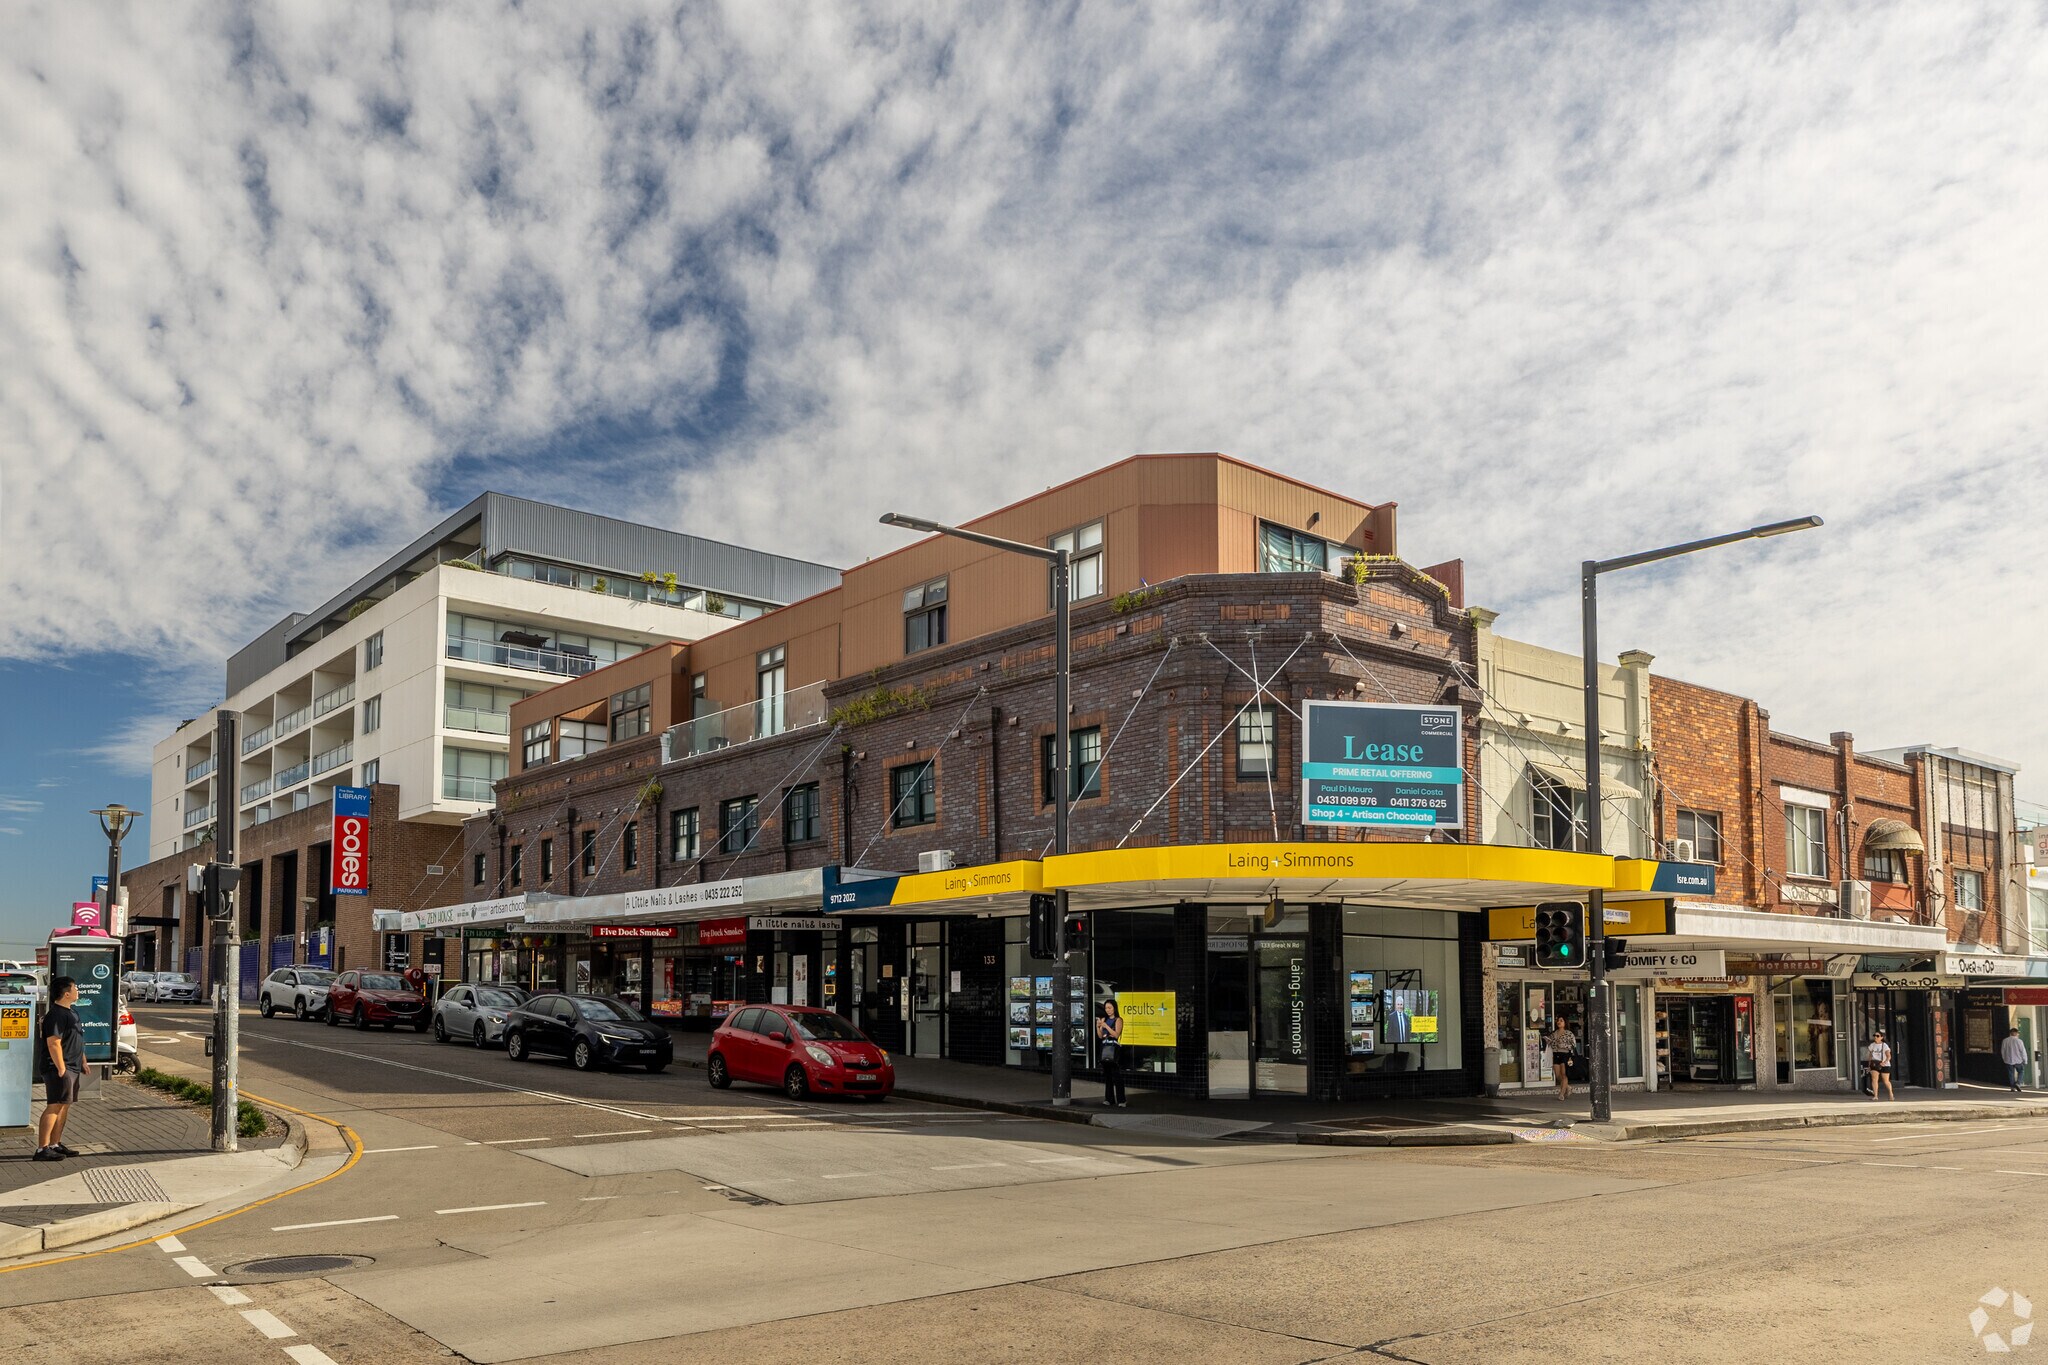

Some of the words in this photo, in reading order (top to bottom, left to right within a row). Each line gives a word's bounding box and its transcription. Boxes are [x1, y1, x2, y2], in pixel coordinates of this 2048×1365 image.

[1344, 735, 1424, 762] Lease
[1332, 767, 1359, 776] PRIME
[1360, 768, 1388, 778] RETAIL
[1390, 769, 1432, 779] OFFERING
[338, 793, 367, 801] LIBRARY
[1396, 787, 1420, 795] Daniel
[1421, 788, 1444, 796] Costa
[1317, 795, 1339, 804] 0431
[1340, 796, 1360, 805] 099
[1361, 797, 1377, 806] 976
[1390, 798, 1409, 807] 0411
[1411, 799, 1428, 808] 376
[1429, 799, 1447, 808] 625
[1312, 809, 1336, 819] Shop
[1337, 810, 1343, 818] 4
[1352, 810, 1384, 819] Artisan
[1386, 811, 1432, 822] Chocolate
[341, 818, 362, 886] coles
[1283, 852, 1354, 867] Simmons
[974, 873, 1011, 887] Simmons
[1676, 874, 1707, 885] lsre.com.au
[626, 897, 630, 908] A
[631, 896, 649, 908] Little
[650, 894, 666, 907] Nails
[668, 894, 673, 905] &
[675, 892, 698, 905] Lashes
[704, 888, 719, 900] 0435
[719, 887, 730, 899] 222
[731, 886, 742, 898] 252
[830, 893, 842, 904] 9712
[843, 893, 855, 902] 2022
[490, 904, 508, 915] artisan
[509, 900, 524, 913] choco
[427, 912, 436, 924] ZEN
[438, 909, 454, 923] HOUSE
[555, 923, 586, 931] chocolate
[757, 919, 762, 927] A
[766, 919, 788, 928] little
[809, 920, 815, 928] &
[819, 920, 840, 929] lashes
[600, 928, 617, 936] Five
[618, 928, 638, 936] Dock
[700, 929, 710, 938] Five
[710, 928, 723, 937] Dock
[984, 956, 996, 964] 133
[1625, 955, 1666, 966] HOMIFY
[1670, 956, 1678, 965] &
[1681, 955, 1697, 965] CO
[1783, 962, 1818, 970] BREAD
[1959, 958, 1976, 973] OVER
[1982, 960, 1994, 974] TOP
[1879, 977, 1907, 987] OVER
[1918, 977, 1938, 986] TOP
[3, 1009, 27, 1018] 2256
[1123, 1002, 1155, 1015] results
[1292, 1000, 1304, 1054] Simmons
